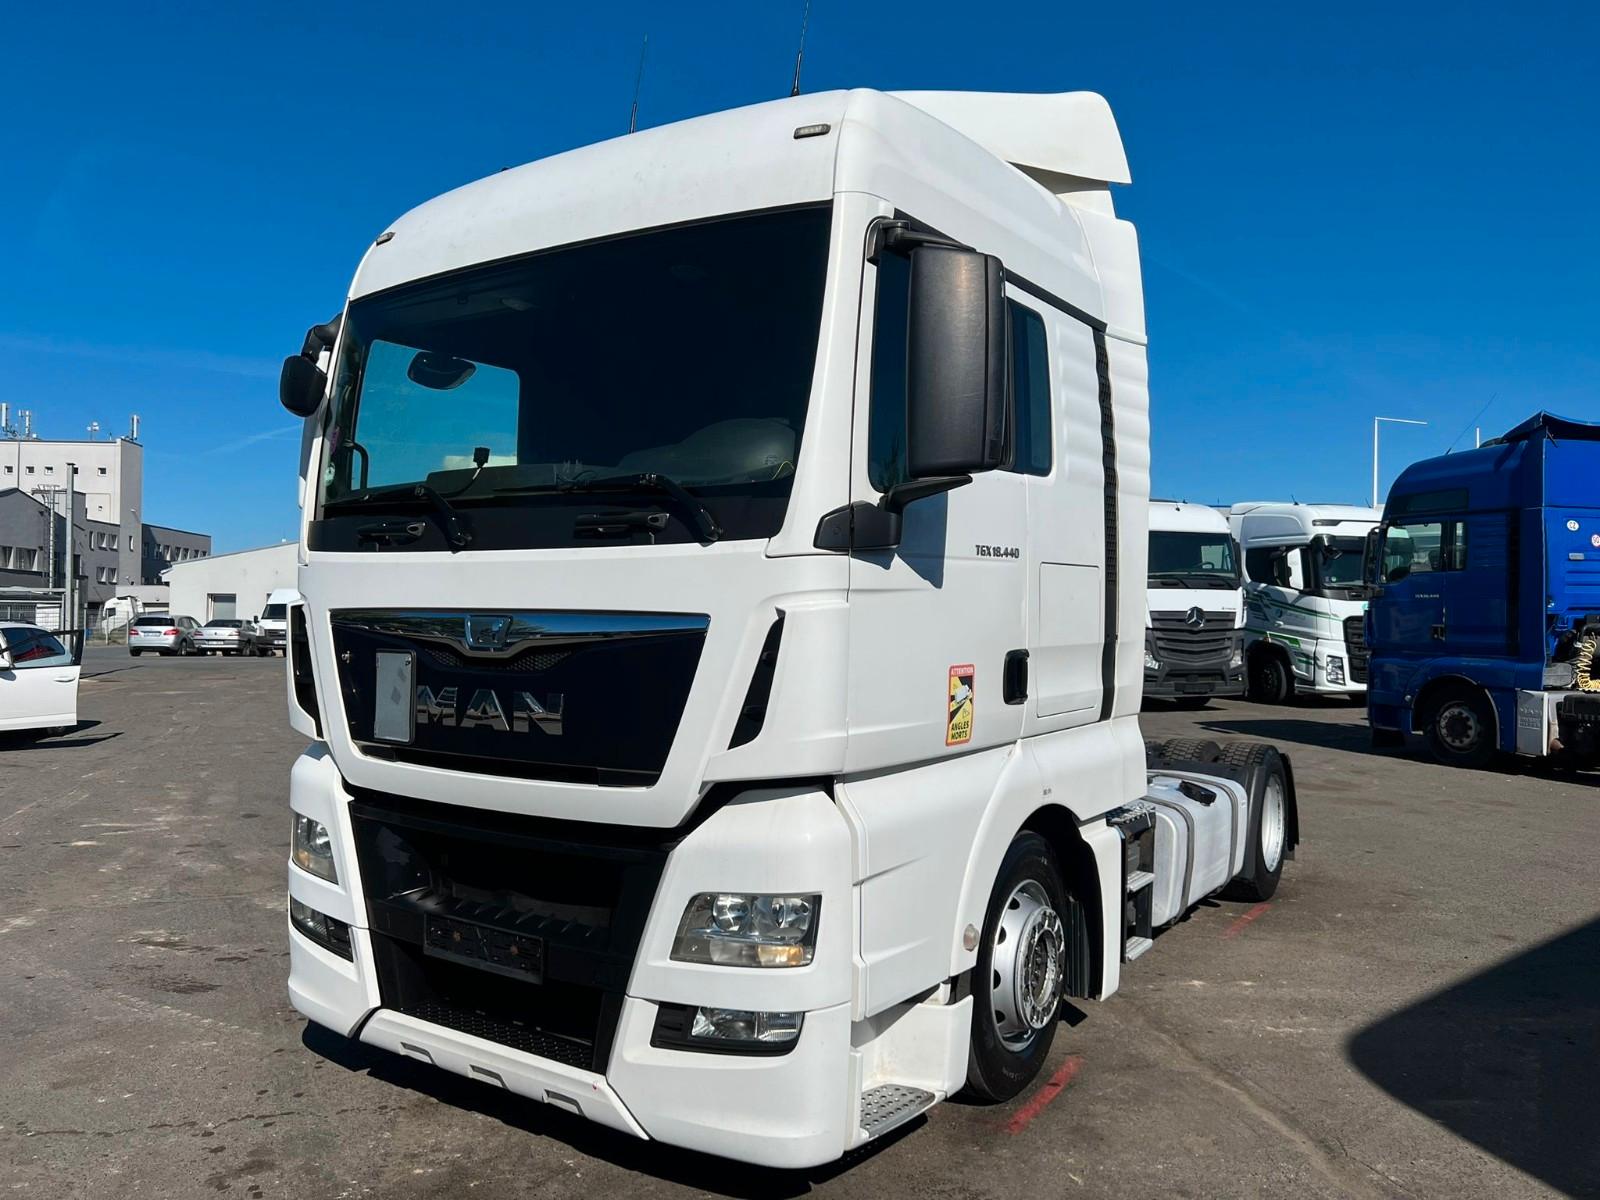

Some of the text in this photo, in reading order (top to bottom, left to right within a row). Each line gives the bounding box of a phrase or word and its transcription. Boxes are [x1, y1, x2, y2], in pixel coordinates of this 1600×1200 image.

[416, 685, 564, 735] MAN
[951, 720, 969, 731] ANGLES
[951, 730, 967, 740] MORTS
